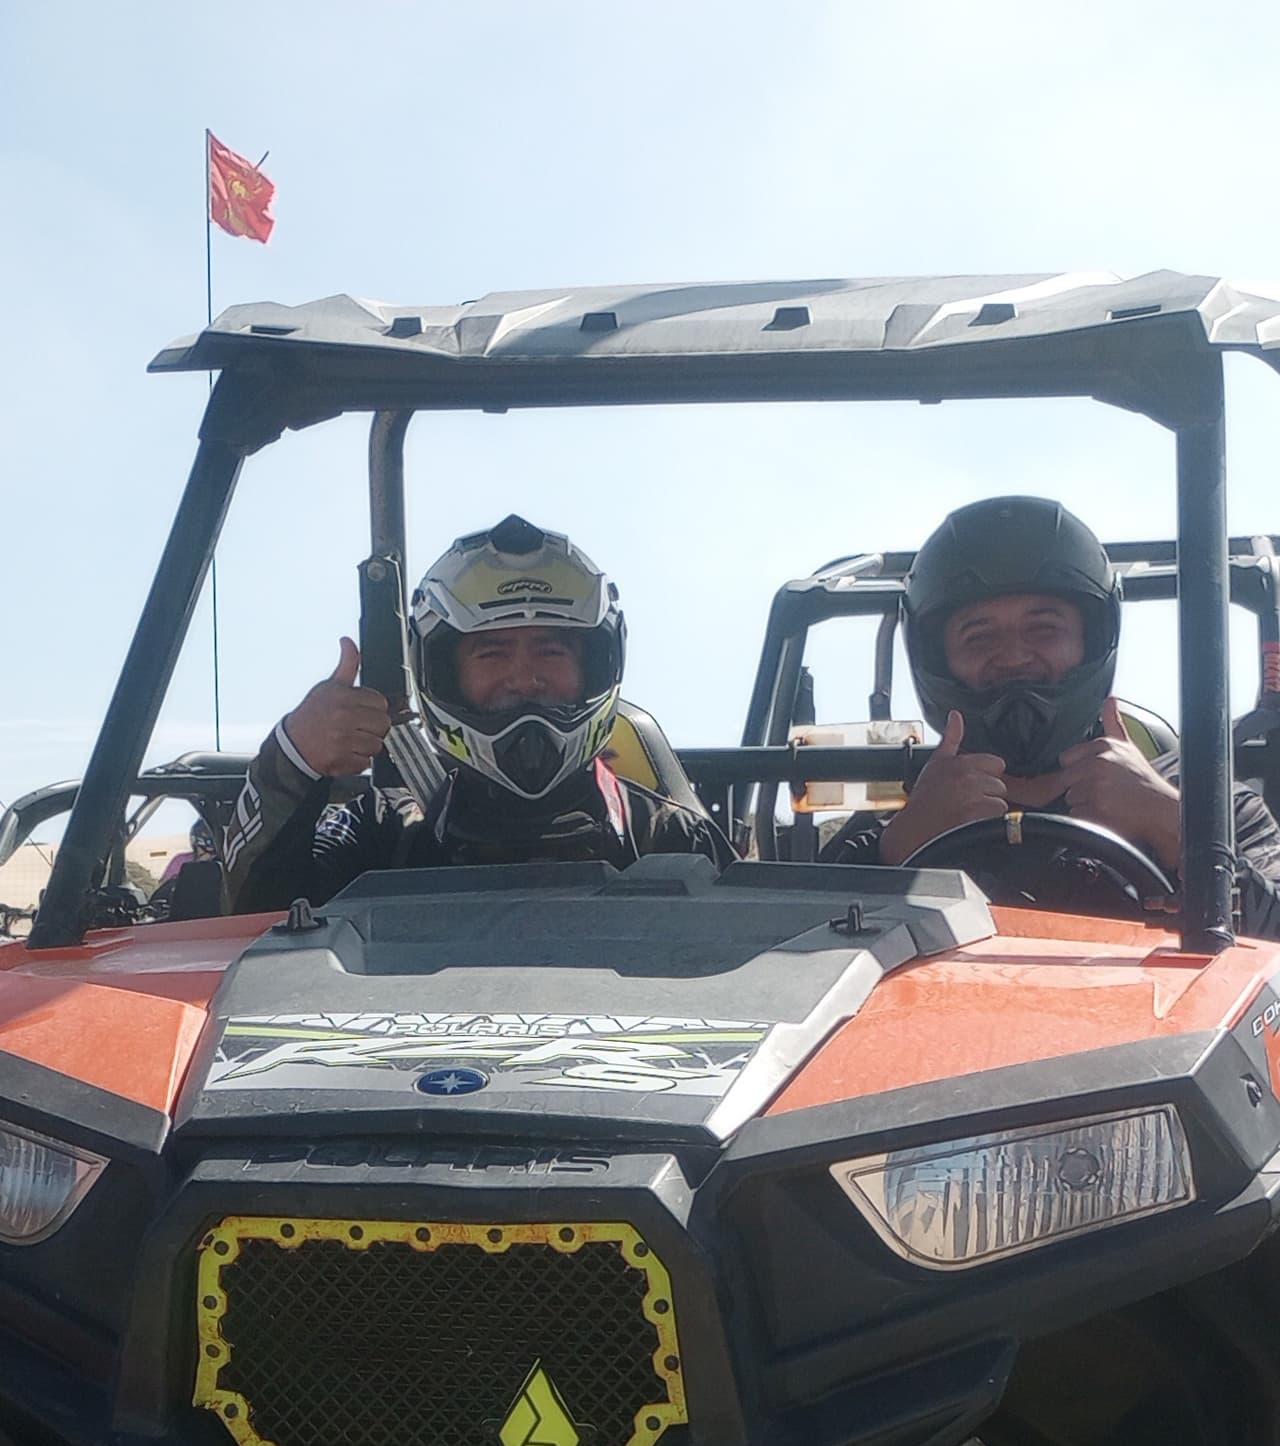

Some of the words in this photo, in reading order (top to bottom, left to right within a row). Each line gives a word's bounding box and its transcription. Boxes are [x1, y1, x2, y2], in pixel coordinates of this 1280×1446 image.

[384, 1021, 571, 1037] POLARIS
[212, 1035, 694, 1084] RZR
[243, 1144, 615, 1175] POLARIS
